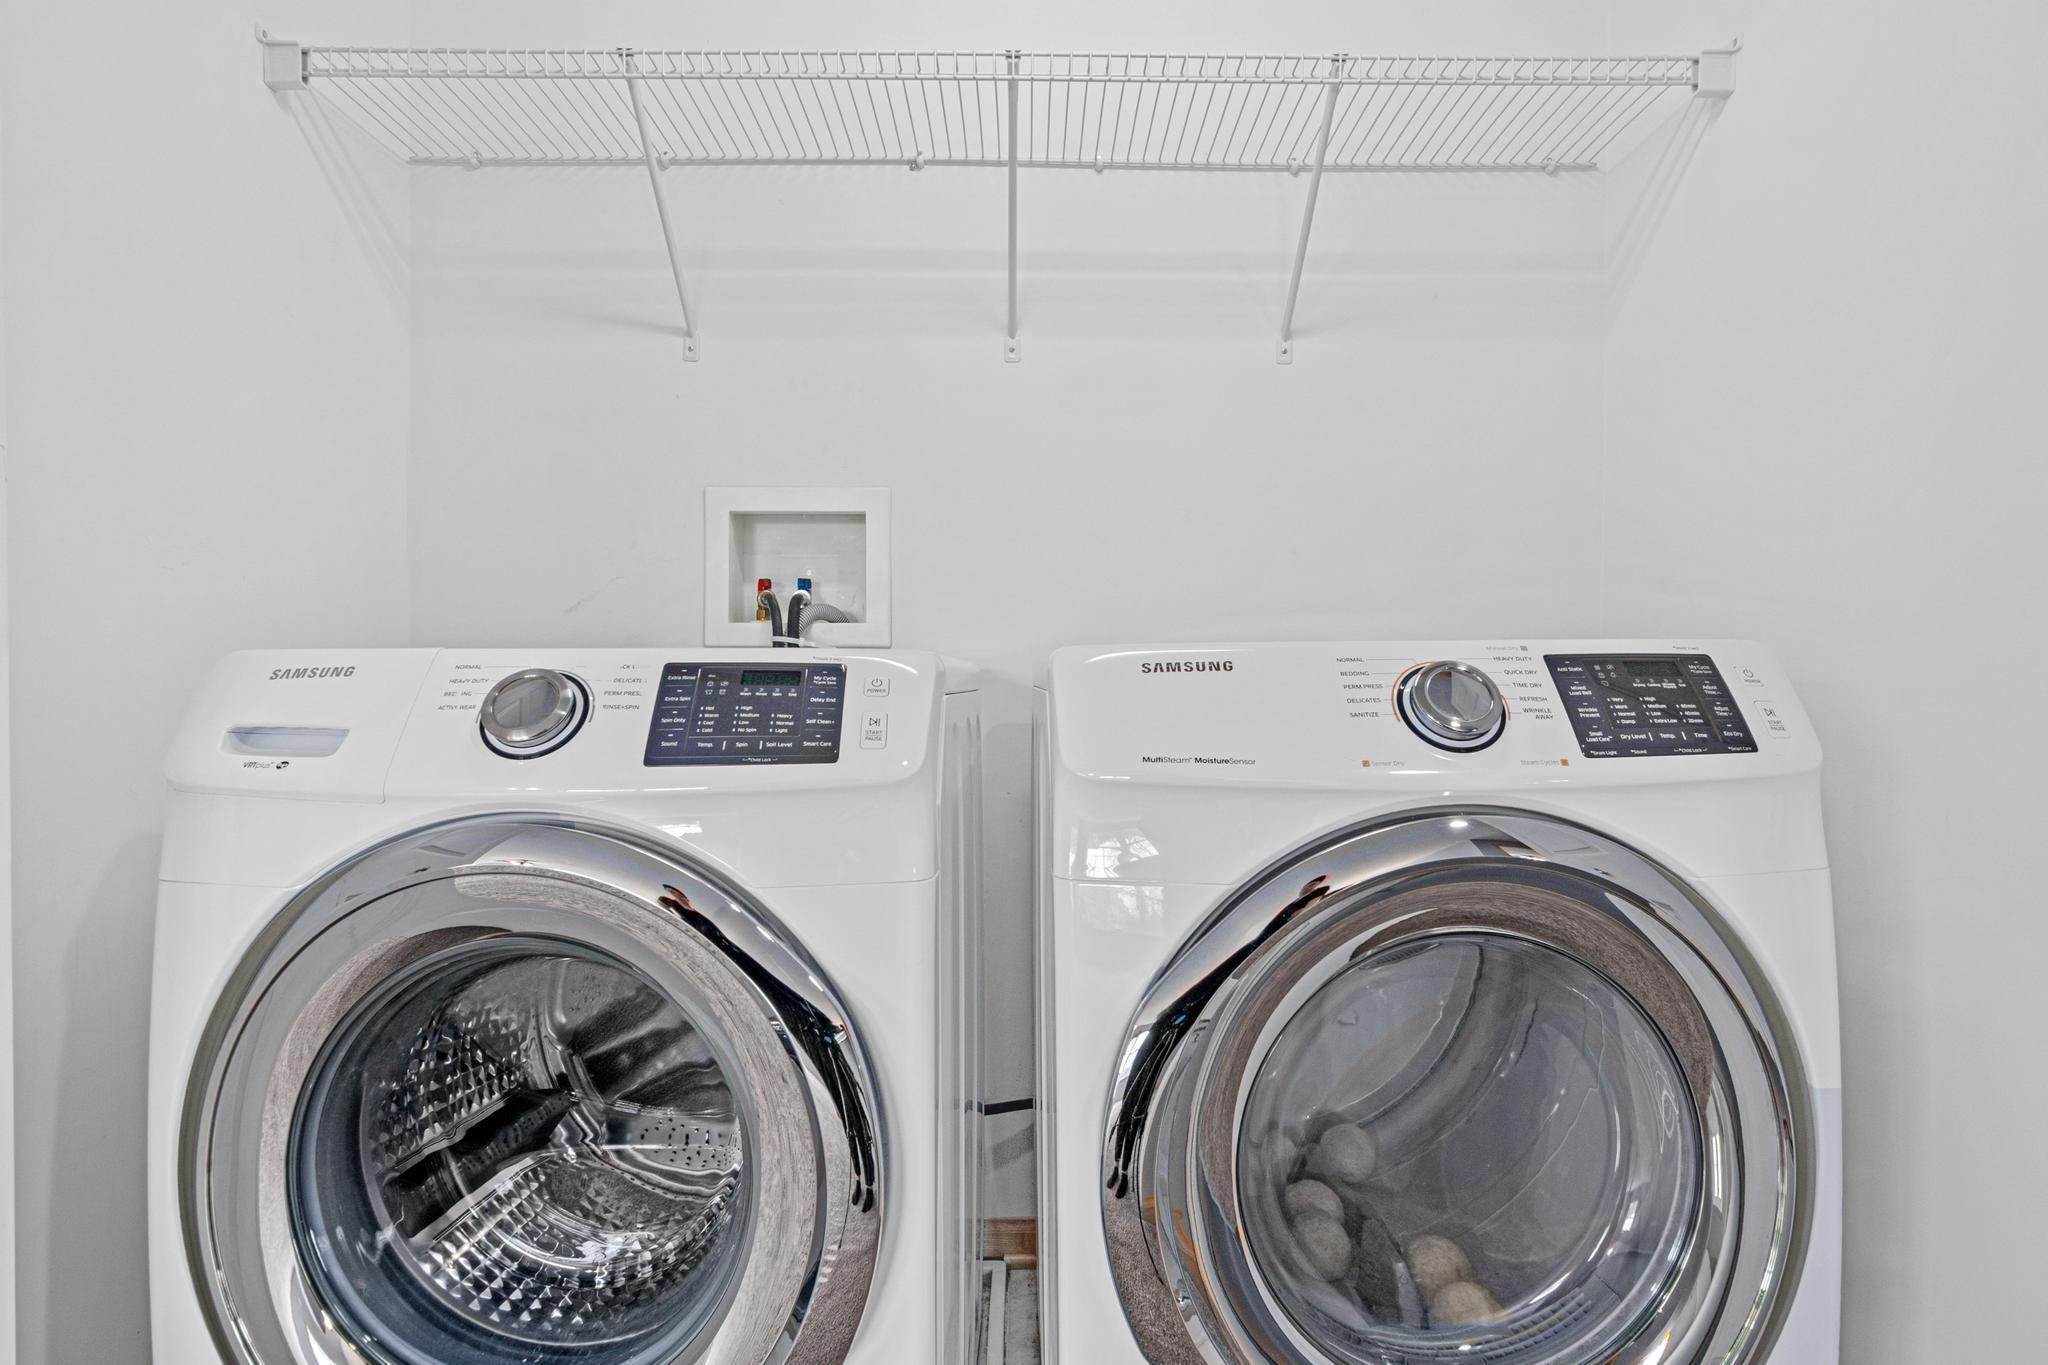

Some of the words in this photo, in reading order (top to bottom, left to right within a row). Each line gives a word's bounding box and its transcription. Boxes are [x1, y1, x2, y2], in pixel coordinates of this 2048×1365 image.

[269, 666, 356, 680] SAMSUNG
[1141, 660, 1234, 674] SAMSUNG
[1194, 757, 1256, 765] MoistureSensor
